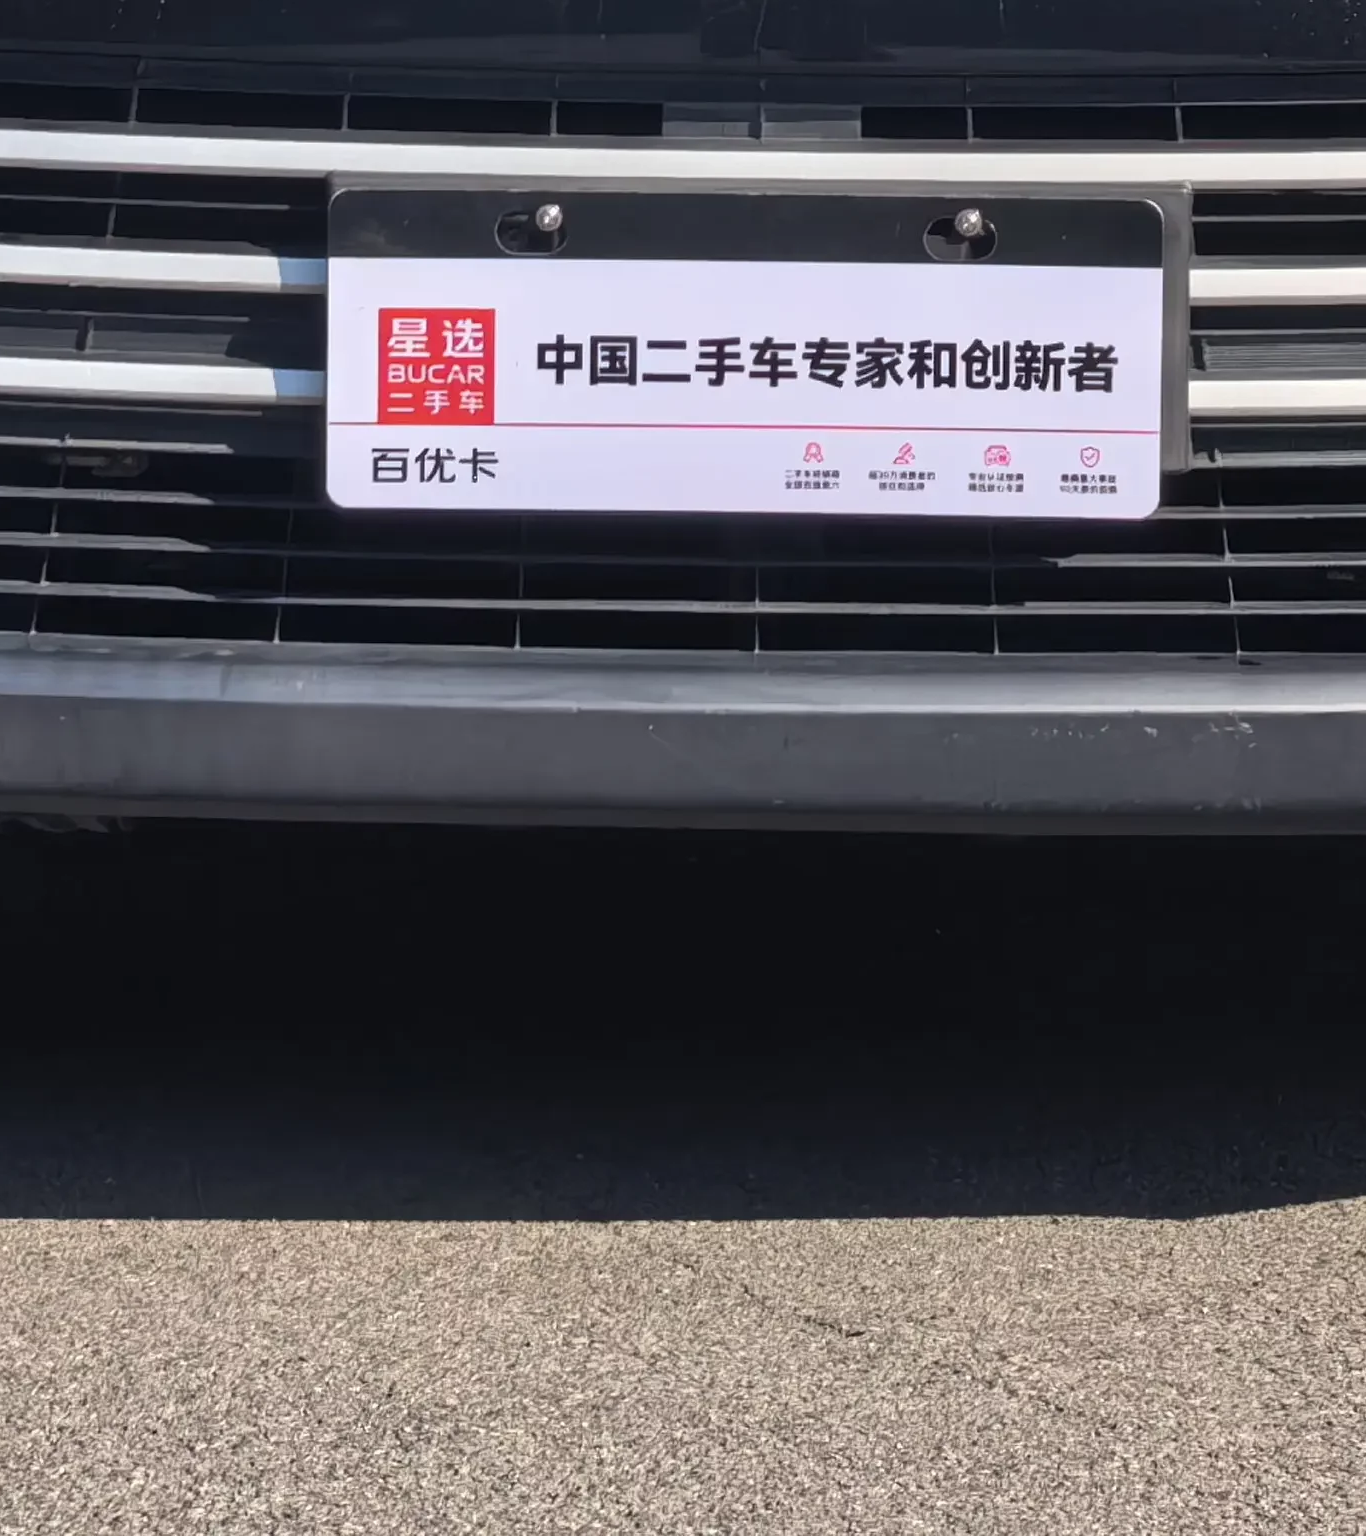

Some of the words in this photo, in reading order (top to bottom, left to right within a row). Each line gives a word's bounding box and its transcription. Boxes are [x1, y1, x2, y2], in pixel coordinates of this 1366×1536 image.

[387, 317, 484, 358] 星选
[387, 364, 484, 384] BUCAR
[537, 334, 1119, 393] 中国二手车专家和创新者
[387, 389, 484, 415] 二手车
[371, 447, 499, 483] 百优卡
